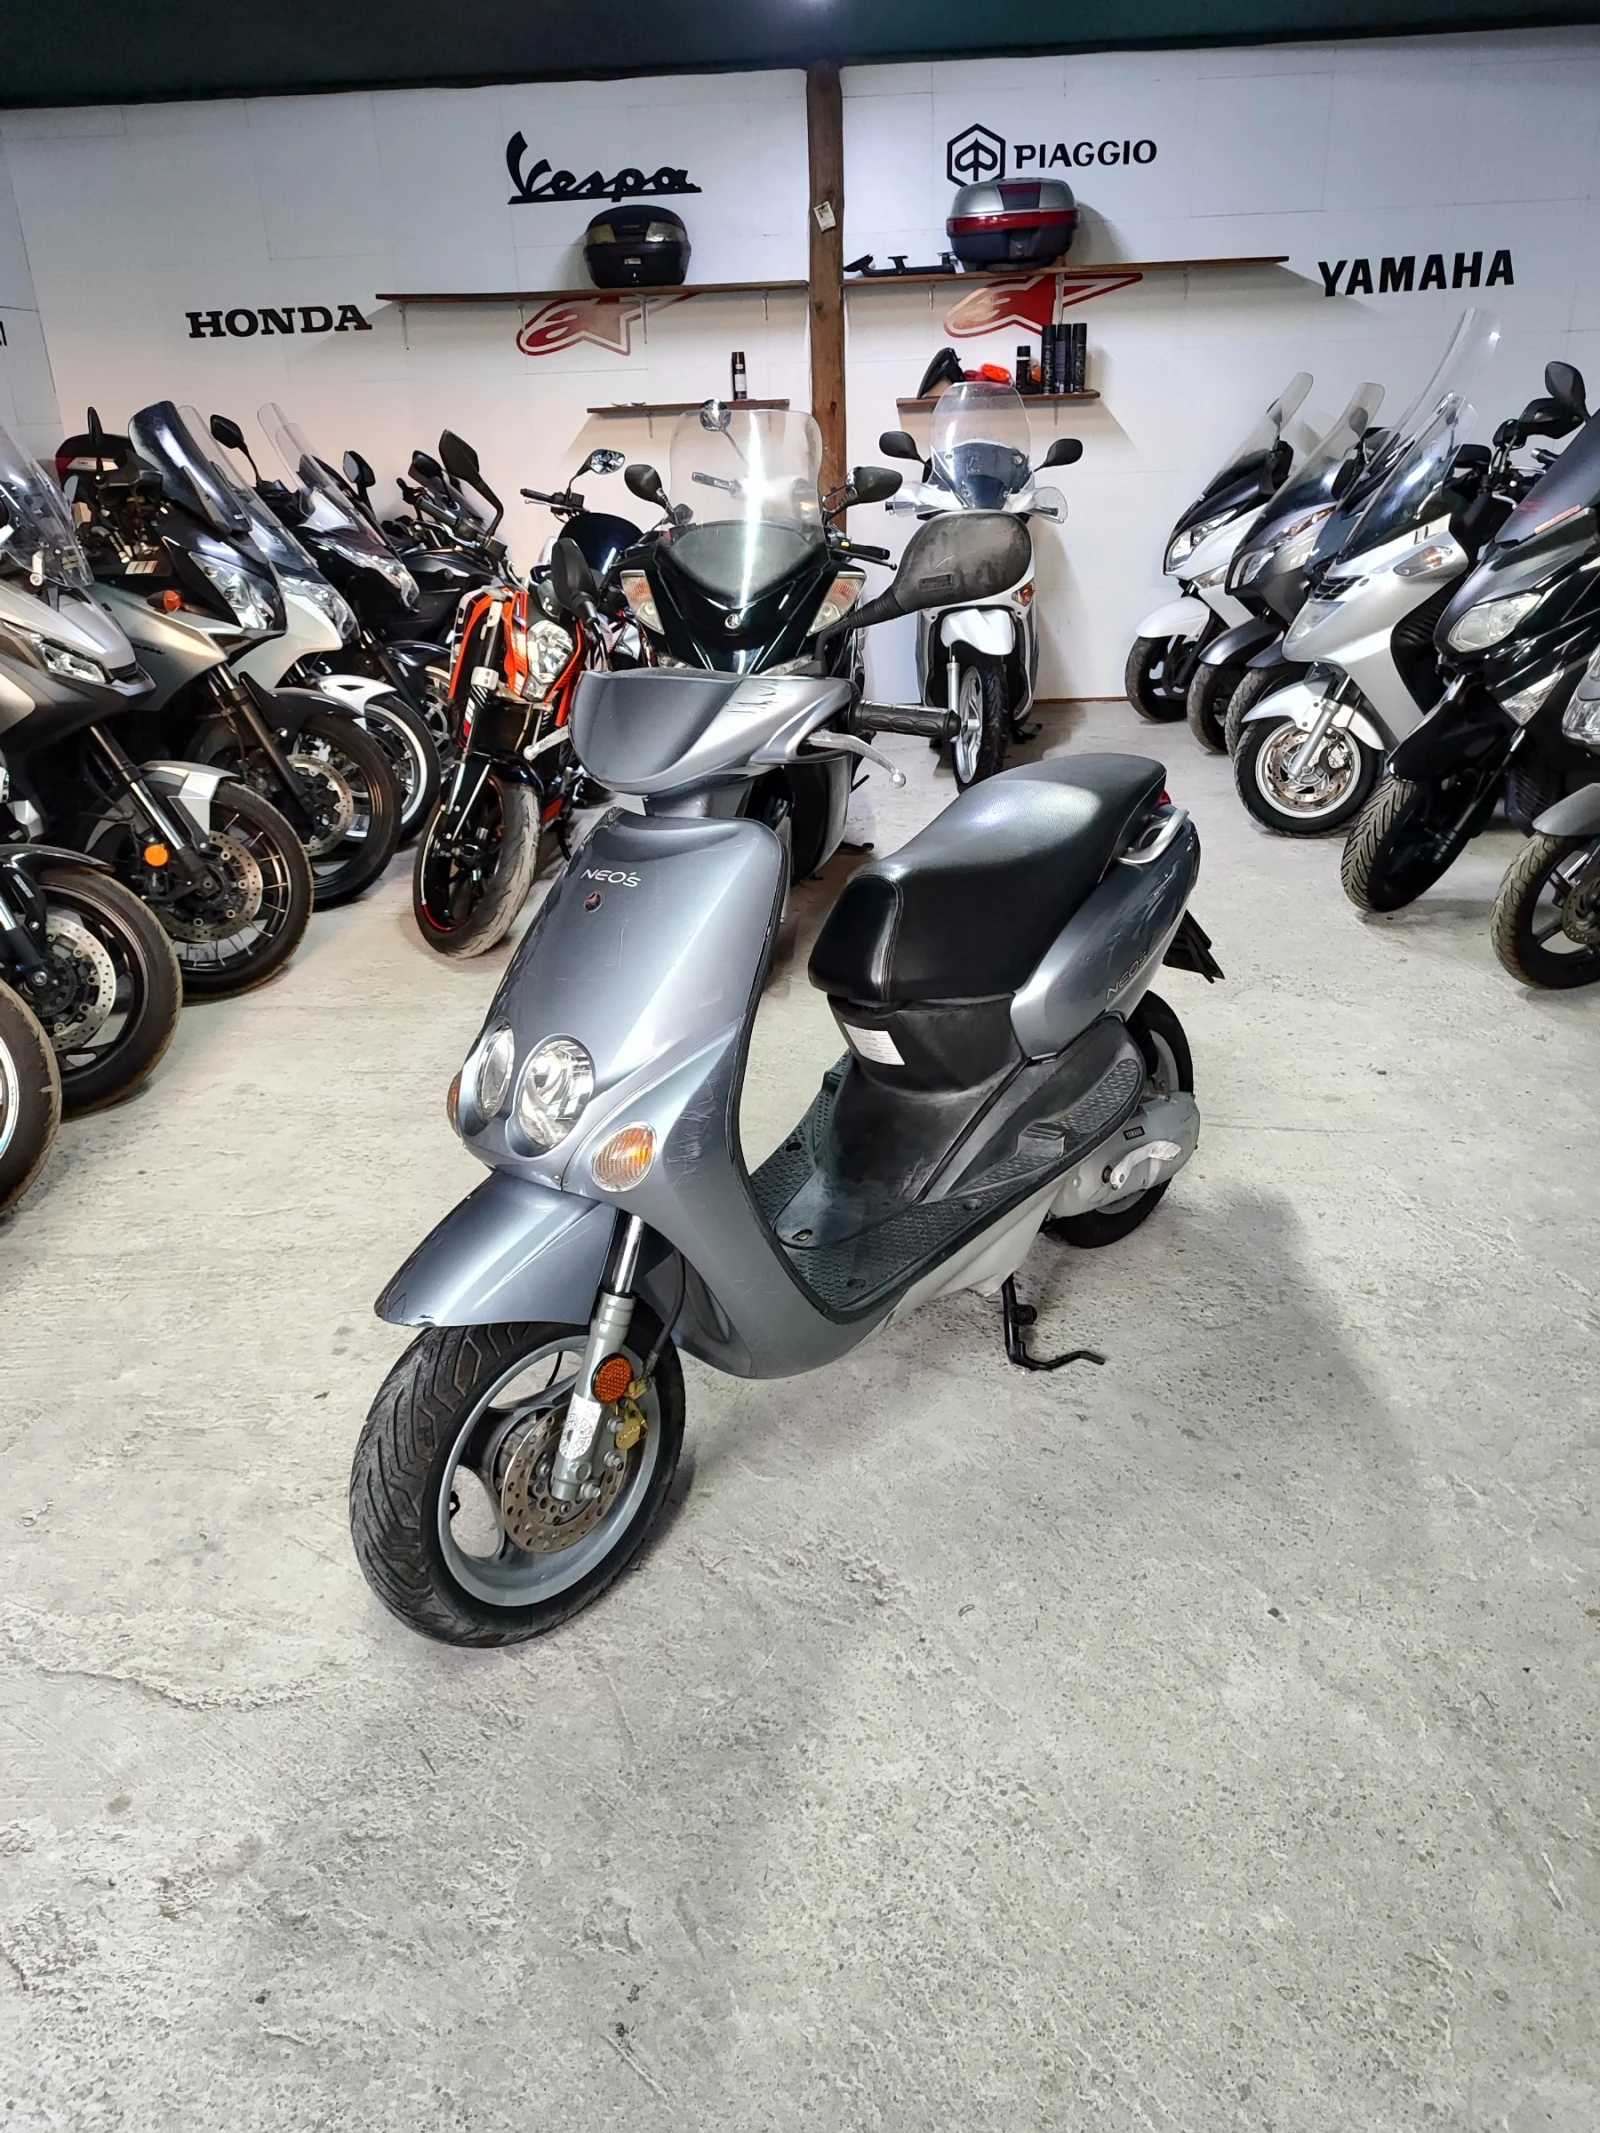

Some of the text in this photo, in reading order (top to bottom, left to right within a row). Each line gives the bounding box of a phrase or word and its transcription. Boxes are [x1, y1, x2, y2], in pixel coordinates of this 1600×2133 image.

[506, 131, 702, 204] Vespa
[1013, 139, 1157, 169] PIAGGIO
[1317, 249, 1515, 297] YAMAHA
[185, 304, 373, 338] HONDA
